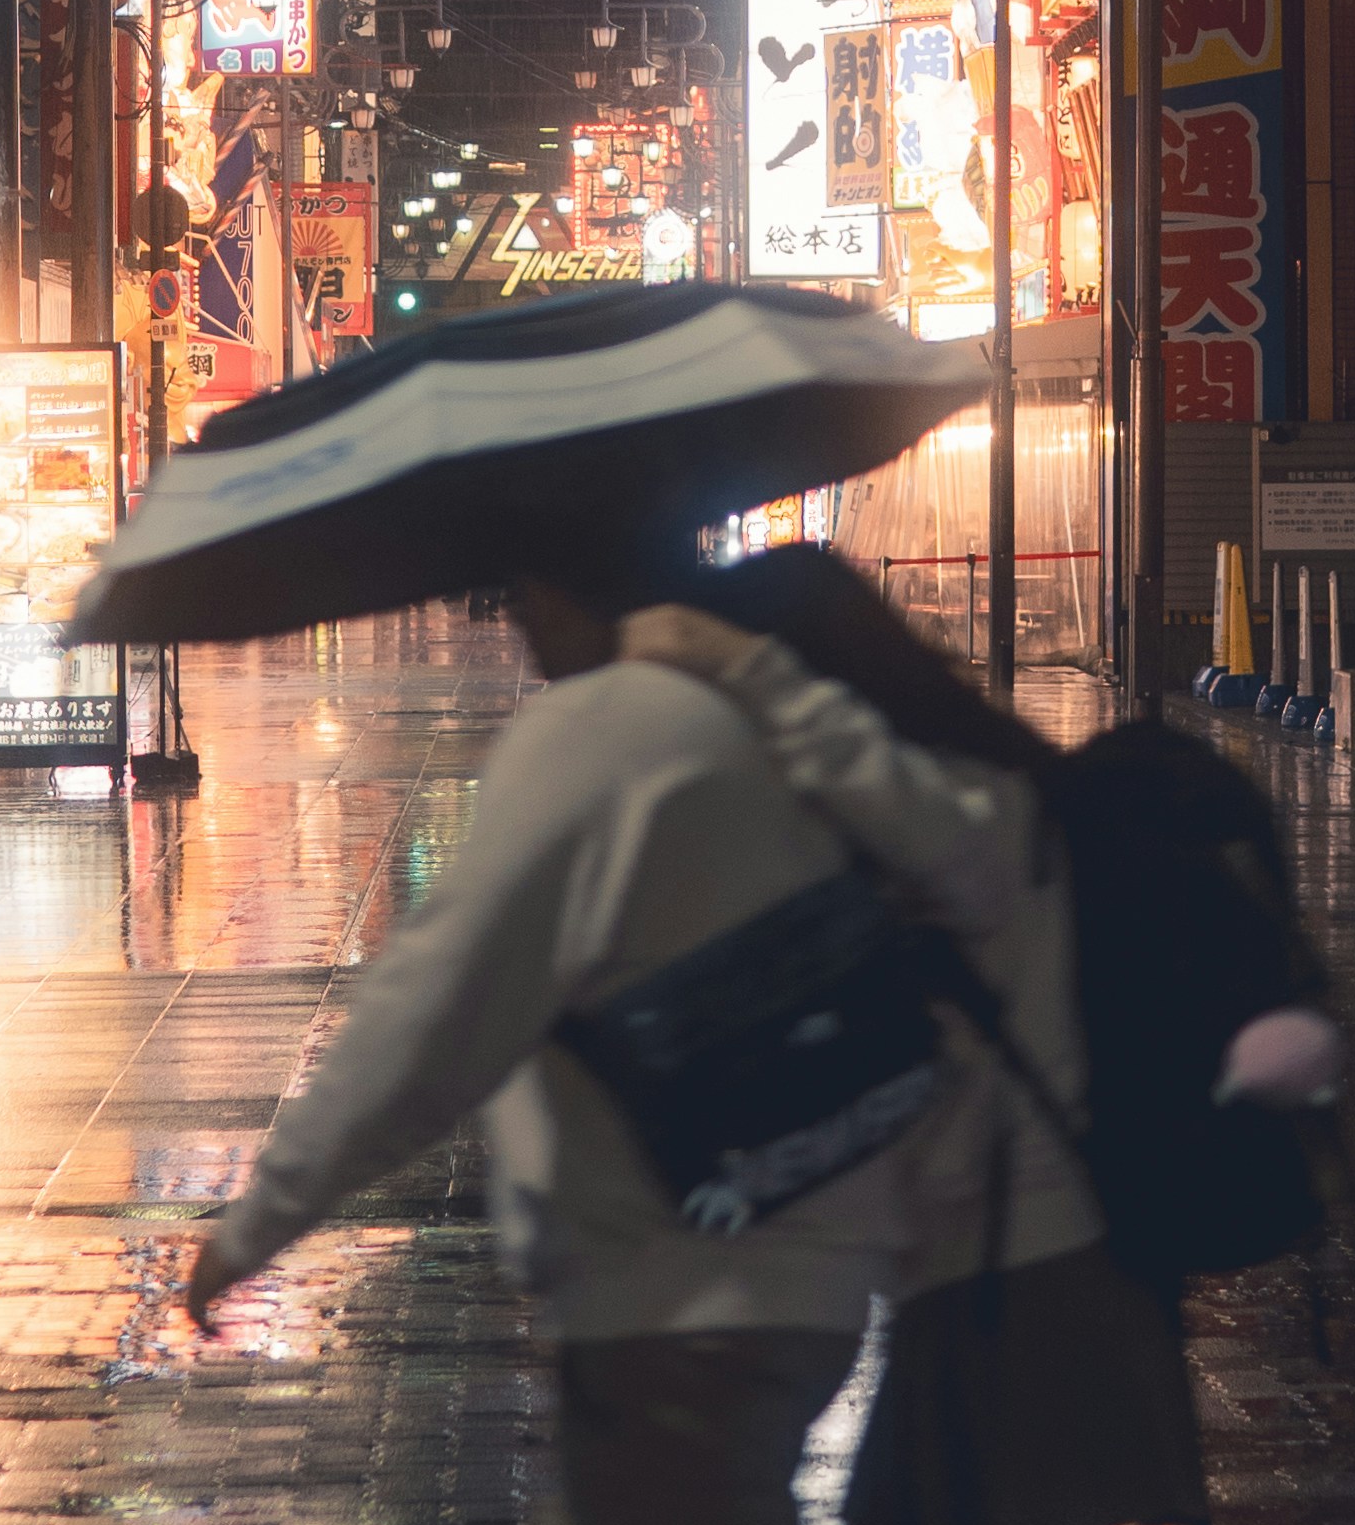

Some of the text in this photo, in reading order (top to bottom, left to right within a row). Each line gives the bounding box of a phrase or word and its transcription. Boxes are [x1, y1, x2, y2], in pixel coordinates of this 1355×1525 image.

[219, 50, 275, 70] 名門
[832, 32, 881, 169] 射的
[764, 224, 864, 255] 総本店
[1160, 110, 1260, 421] 通天閣
[152, 325, 178, 336] 自動車
